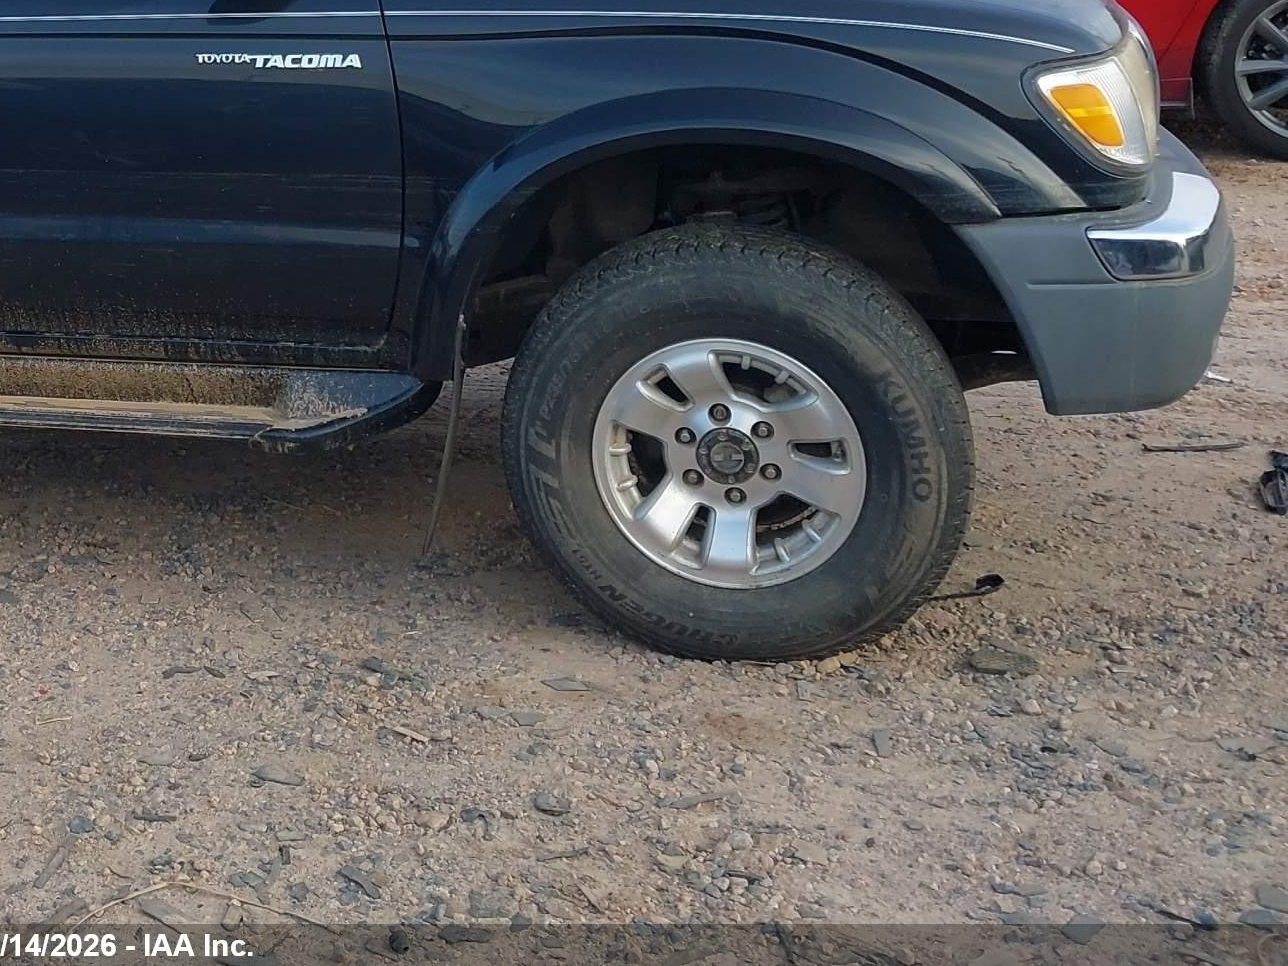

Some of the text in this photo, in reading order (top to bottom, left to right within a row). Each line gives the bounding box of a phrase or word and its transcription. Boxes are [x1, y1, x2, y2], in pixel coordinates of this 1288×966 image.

[196, 53, 362, 68] TOYOTA TACOMA
[872, 371, 933, 502] KUMHO
